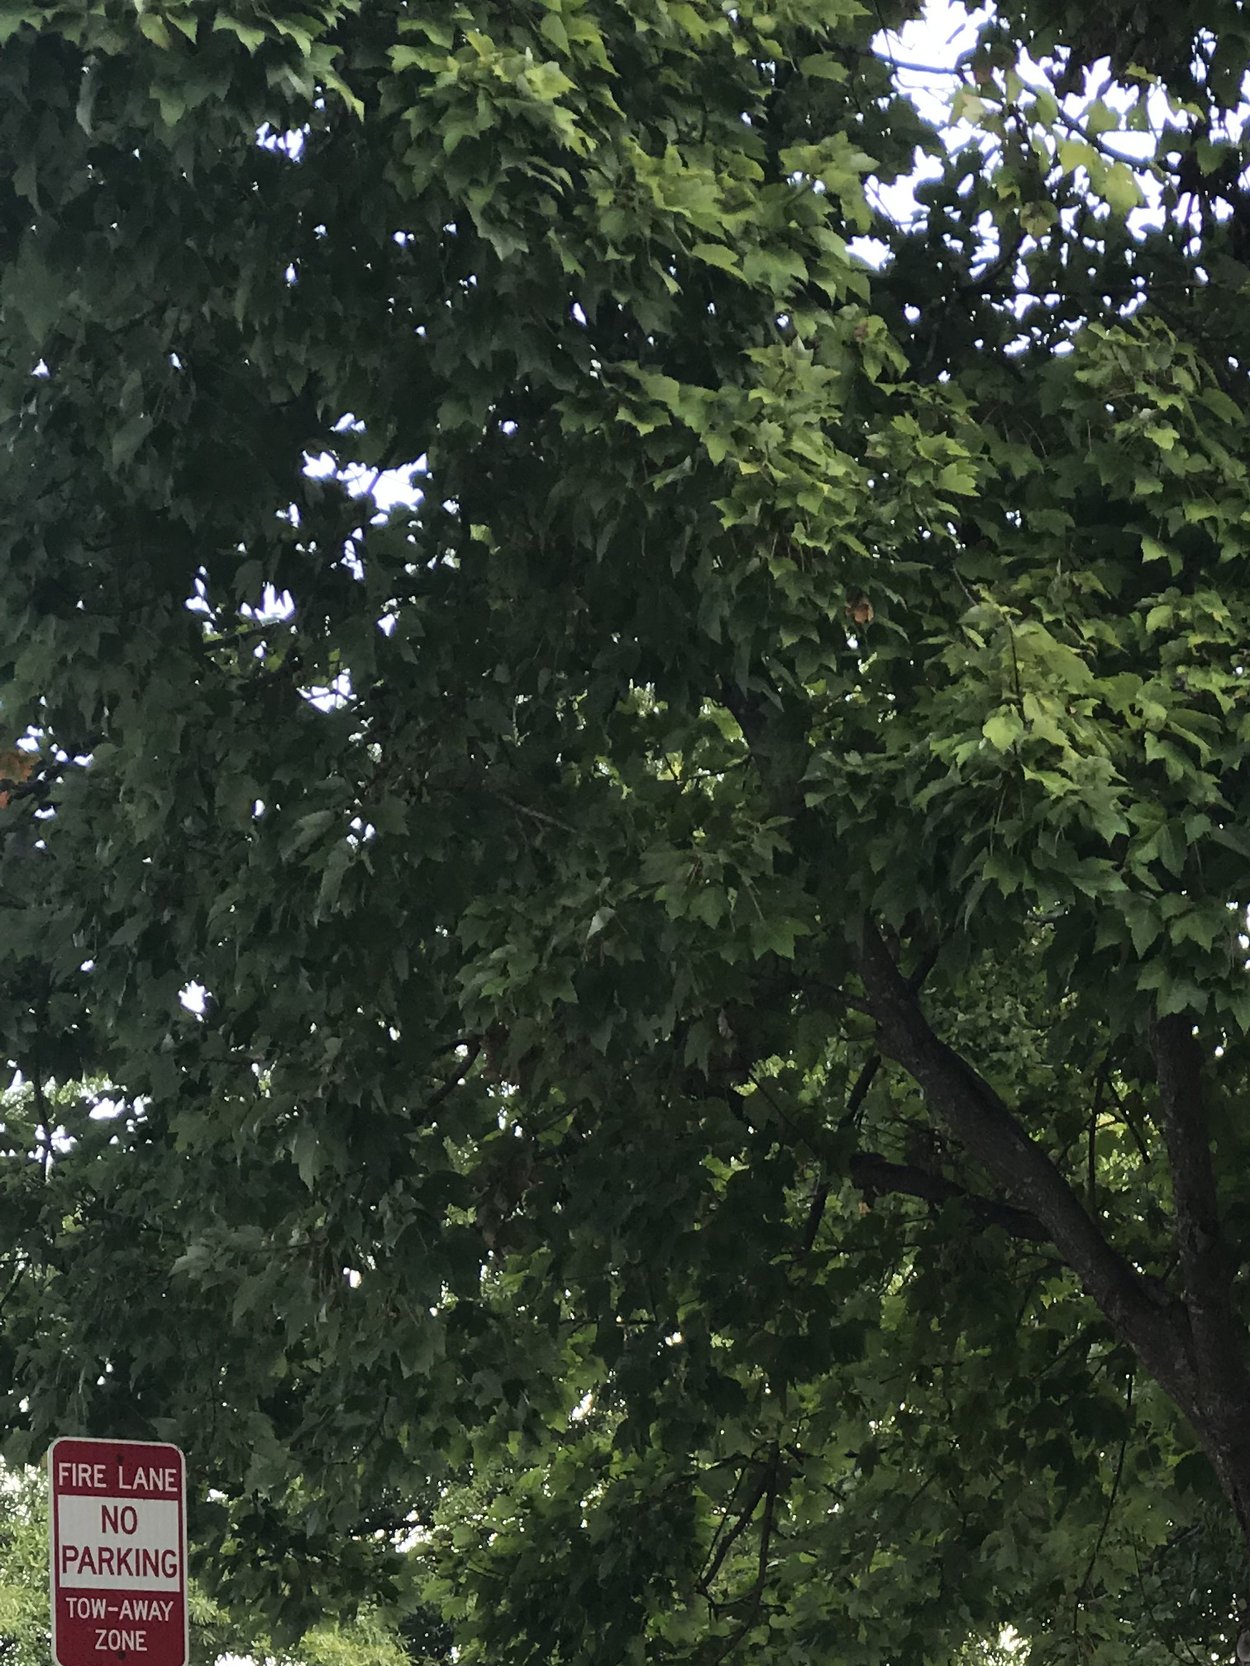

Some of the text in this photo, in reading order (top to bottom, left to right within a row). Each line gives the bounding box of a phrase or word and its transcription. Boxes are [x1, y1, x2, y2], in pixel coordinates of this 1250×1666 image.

[58, 1462, 178, 1492] FIRE LANE
[101, 1504, 138, 1535] NO
[61, 1545, 178, 1579] PARKING
[65, 1597, 174, 1622] TOW-AWAY
[95, 1629, 147, 1651] ZONE
